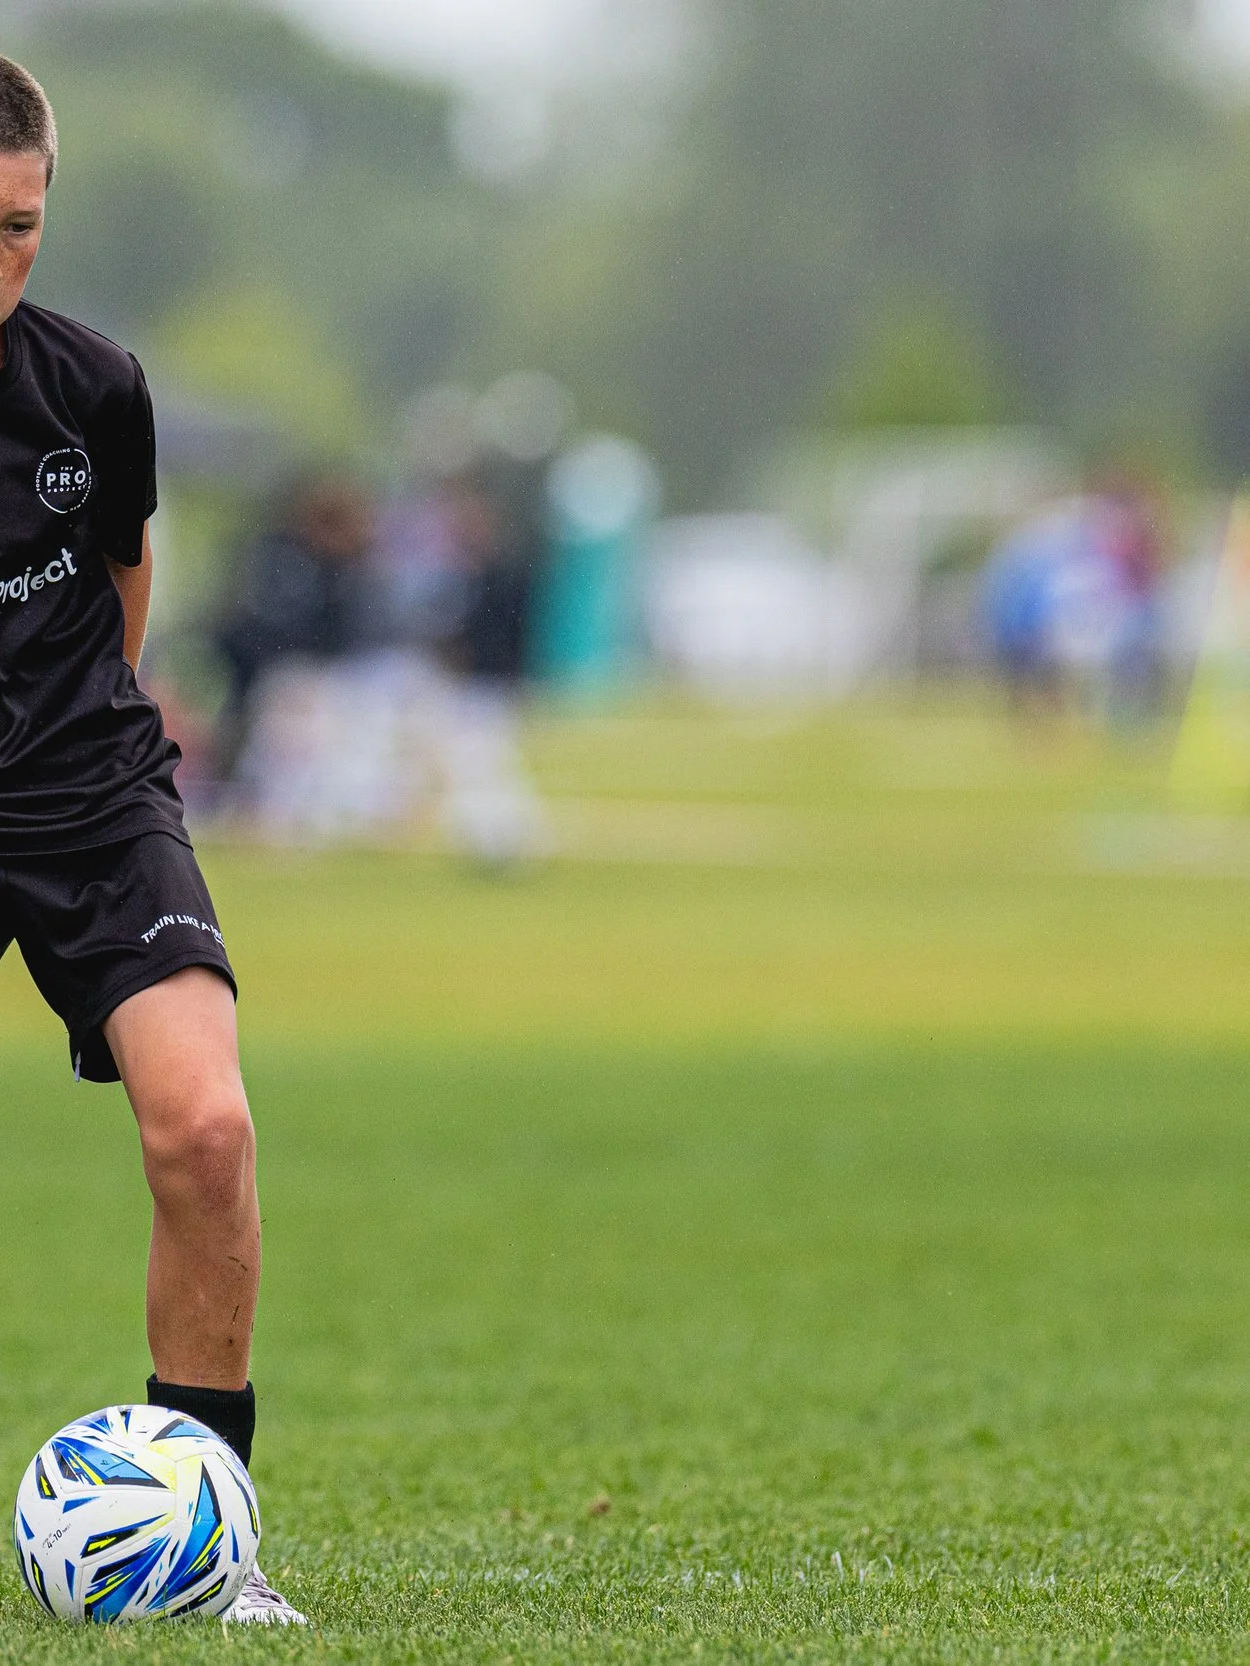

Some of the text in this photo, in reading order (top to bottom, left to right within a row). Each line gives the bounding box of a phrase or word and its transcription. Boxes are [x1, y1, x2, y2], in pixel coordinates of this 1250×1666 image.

[46, 470, 86, 486] PRO
[141, 915, 175, 943] TRAIN
[176, 915, 200, 929] LIKE
[201, 922, 211, 931] A
